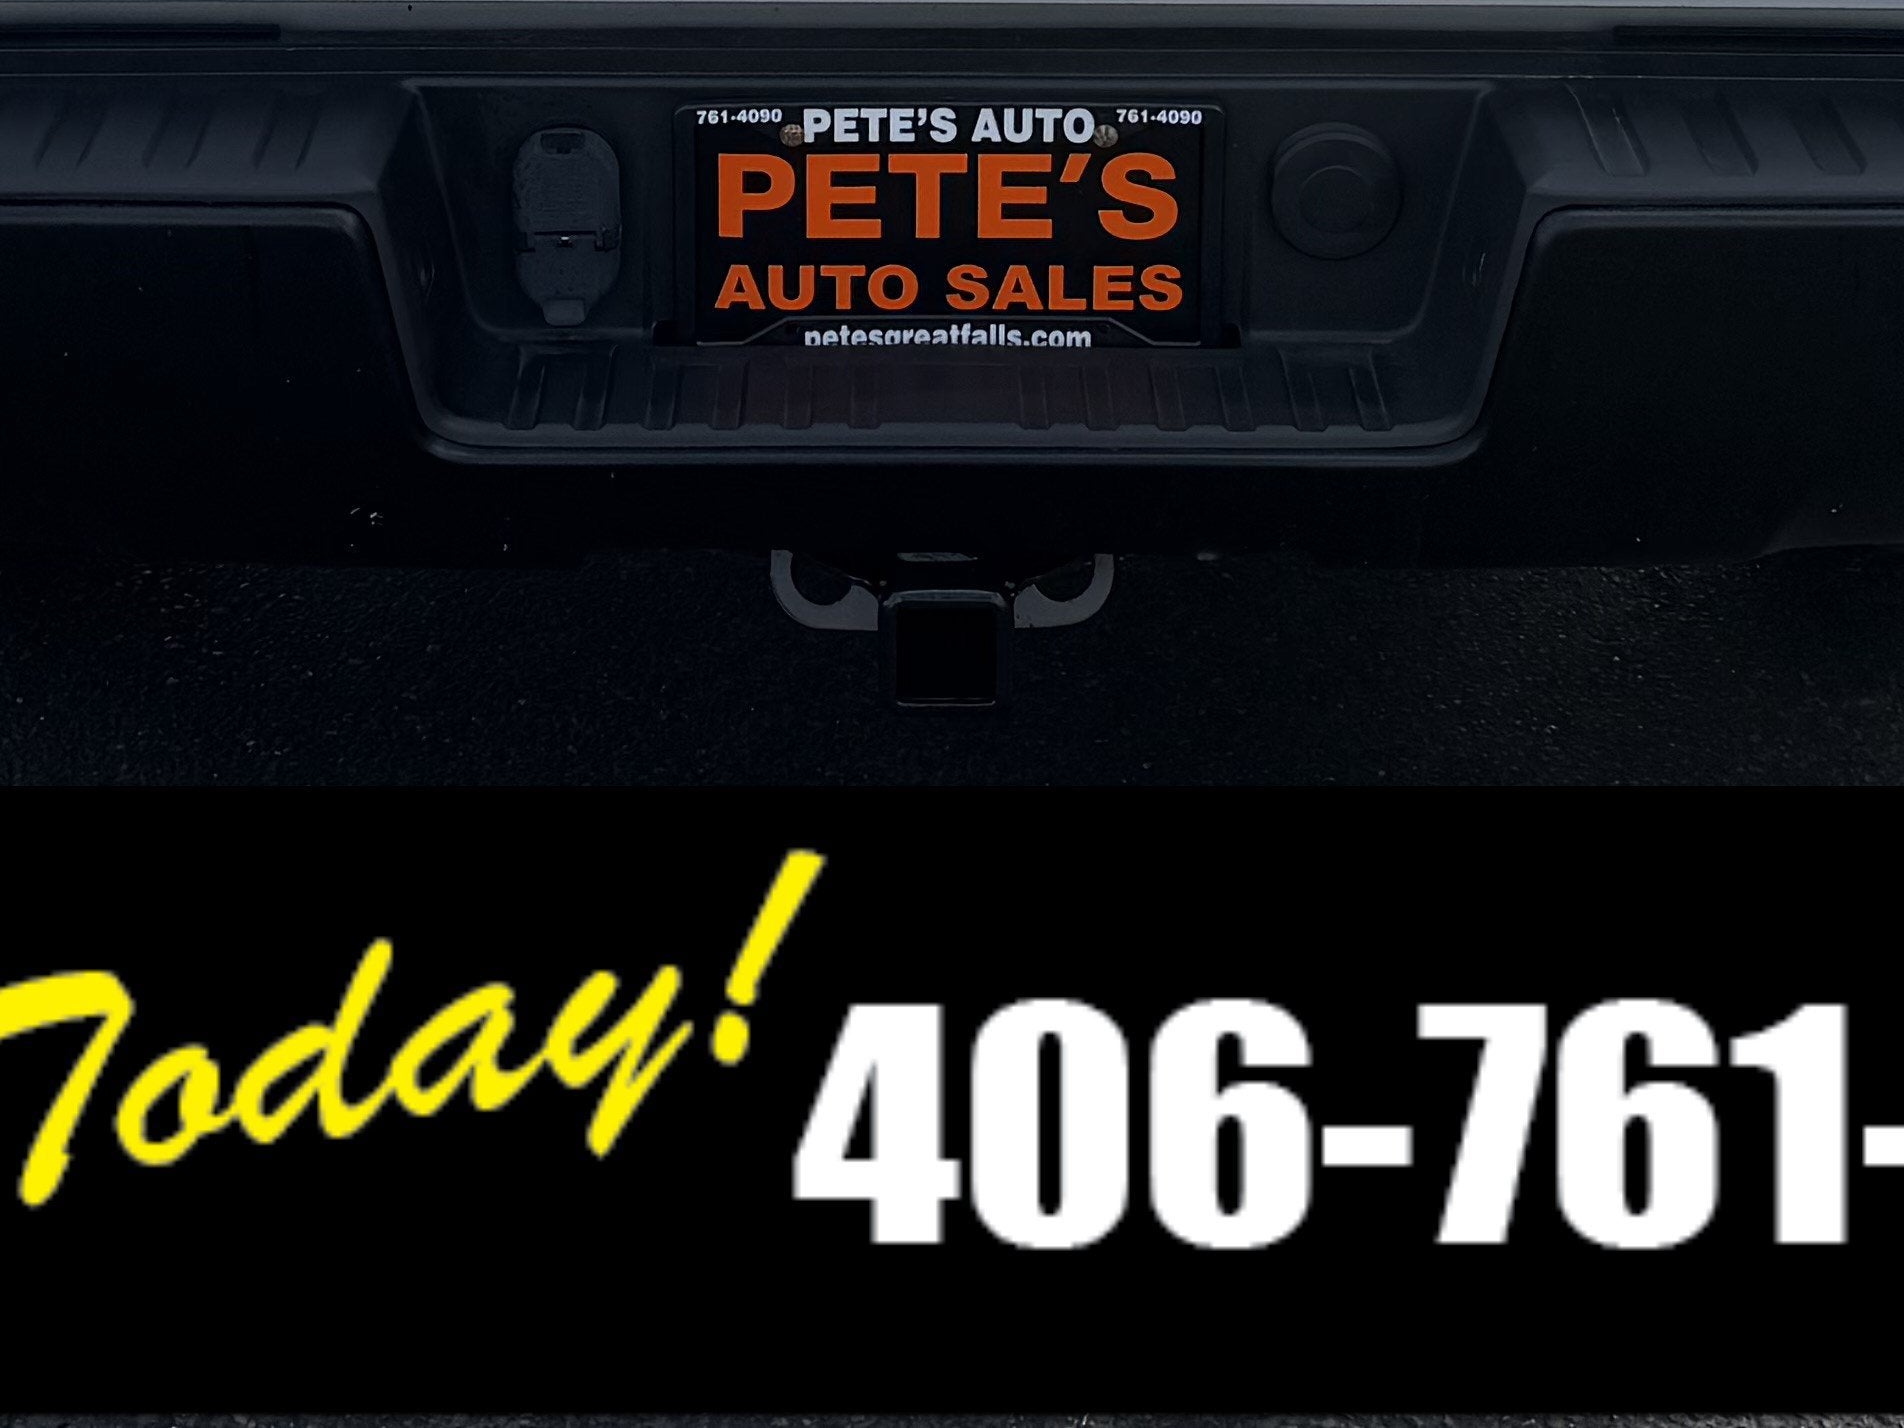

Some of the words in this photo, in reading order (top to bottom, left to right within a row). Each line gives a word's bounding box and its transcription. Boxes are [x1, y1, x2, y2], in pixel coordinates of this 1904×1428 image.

[803, 107, 957, 143] PETE'S
[971, 107, 1095, 143] AUTO
[718, 152, 1178, 240] PETE'S
[714, 264, 919, 310] AUTO
[945, 264, 1183, 310] SALES
[804, 323, 1092, 347] petesgreatfalls.com
